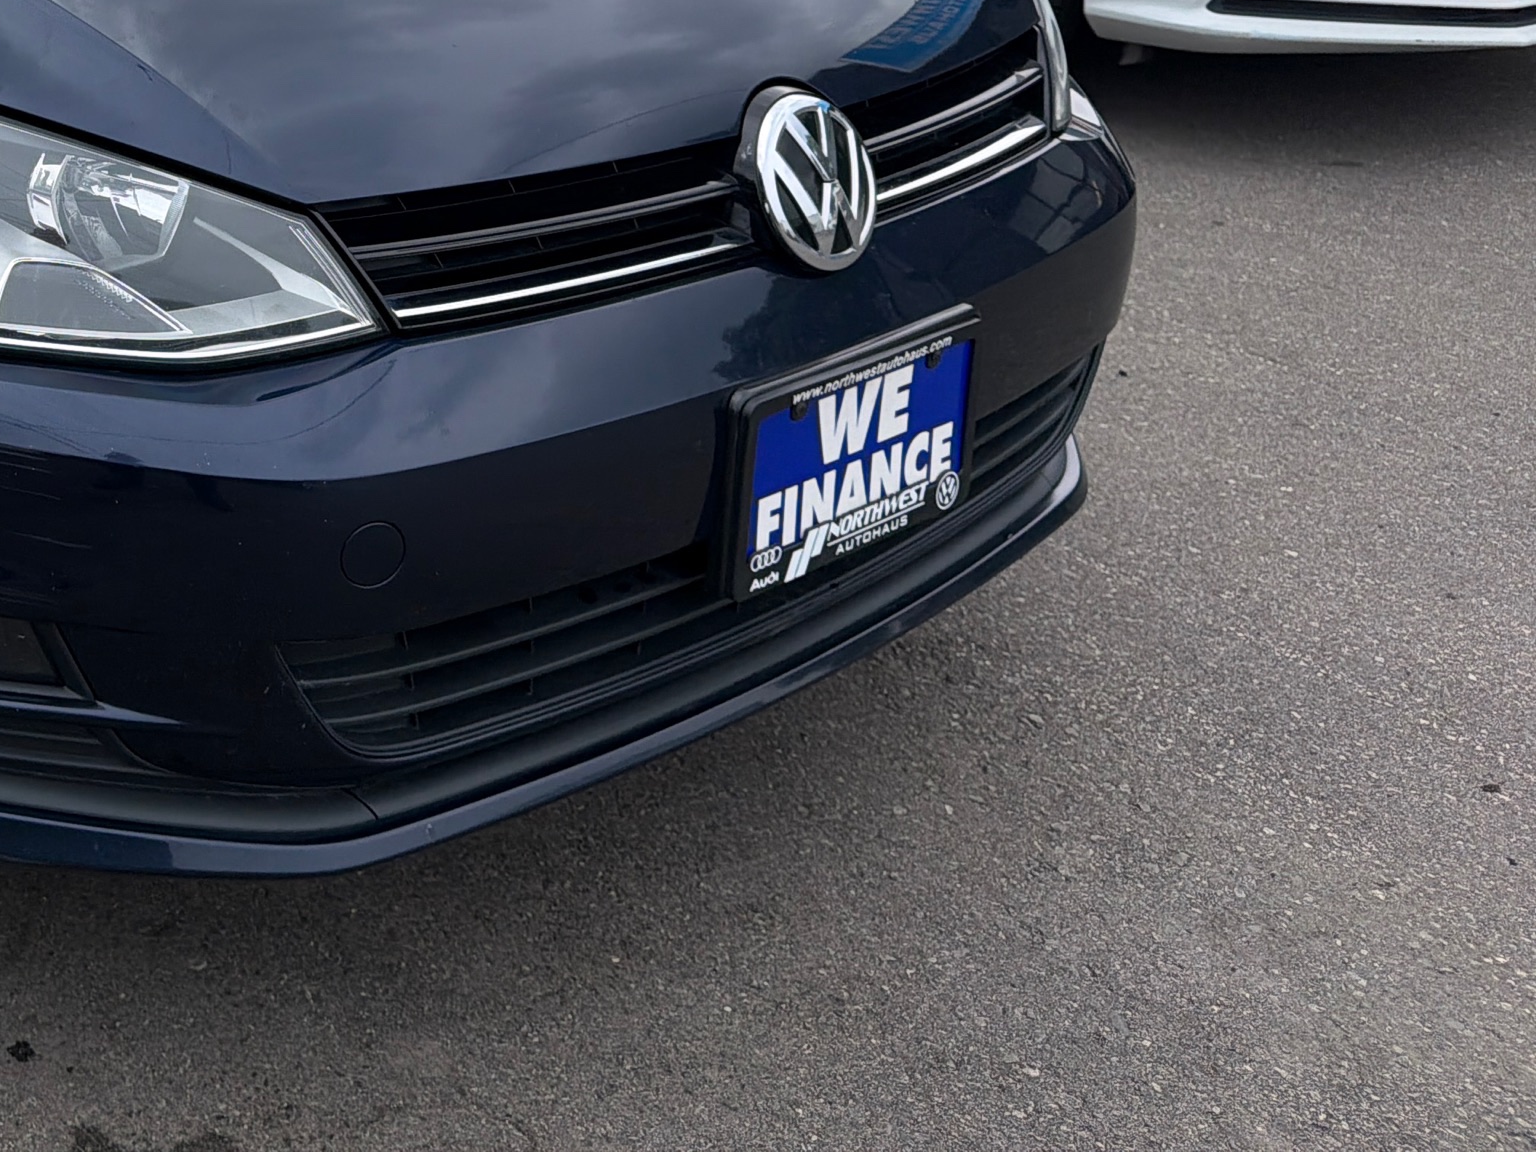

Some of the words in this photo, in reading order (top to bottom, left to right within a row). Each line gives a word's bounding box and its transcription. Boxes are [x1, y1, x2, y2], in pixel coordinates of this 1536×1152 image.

[791, 335, 953, 405] www.northwestautohaus.com
[818, 364, 914, 465] WE
[755, 421, 954, 551] FINANCE
[827, 480, 929, 541] NORTHWEST
[835, 514, 909, 556] AUTOHAUS
[749, 570, 780, 593] Audi
